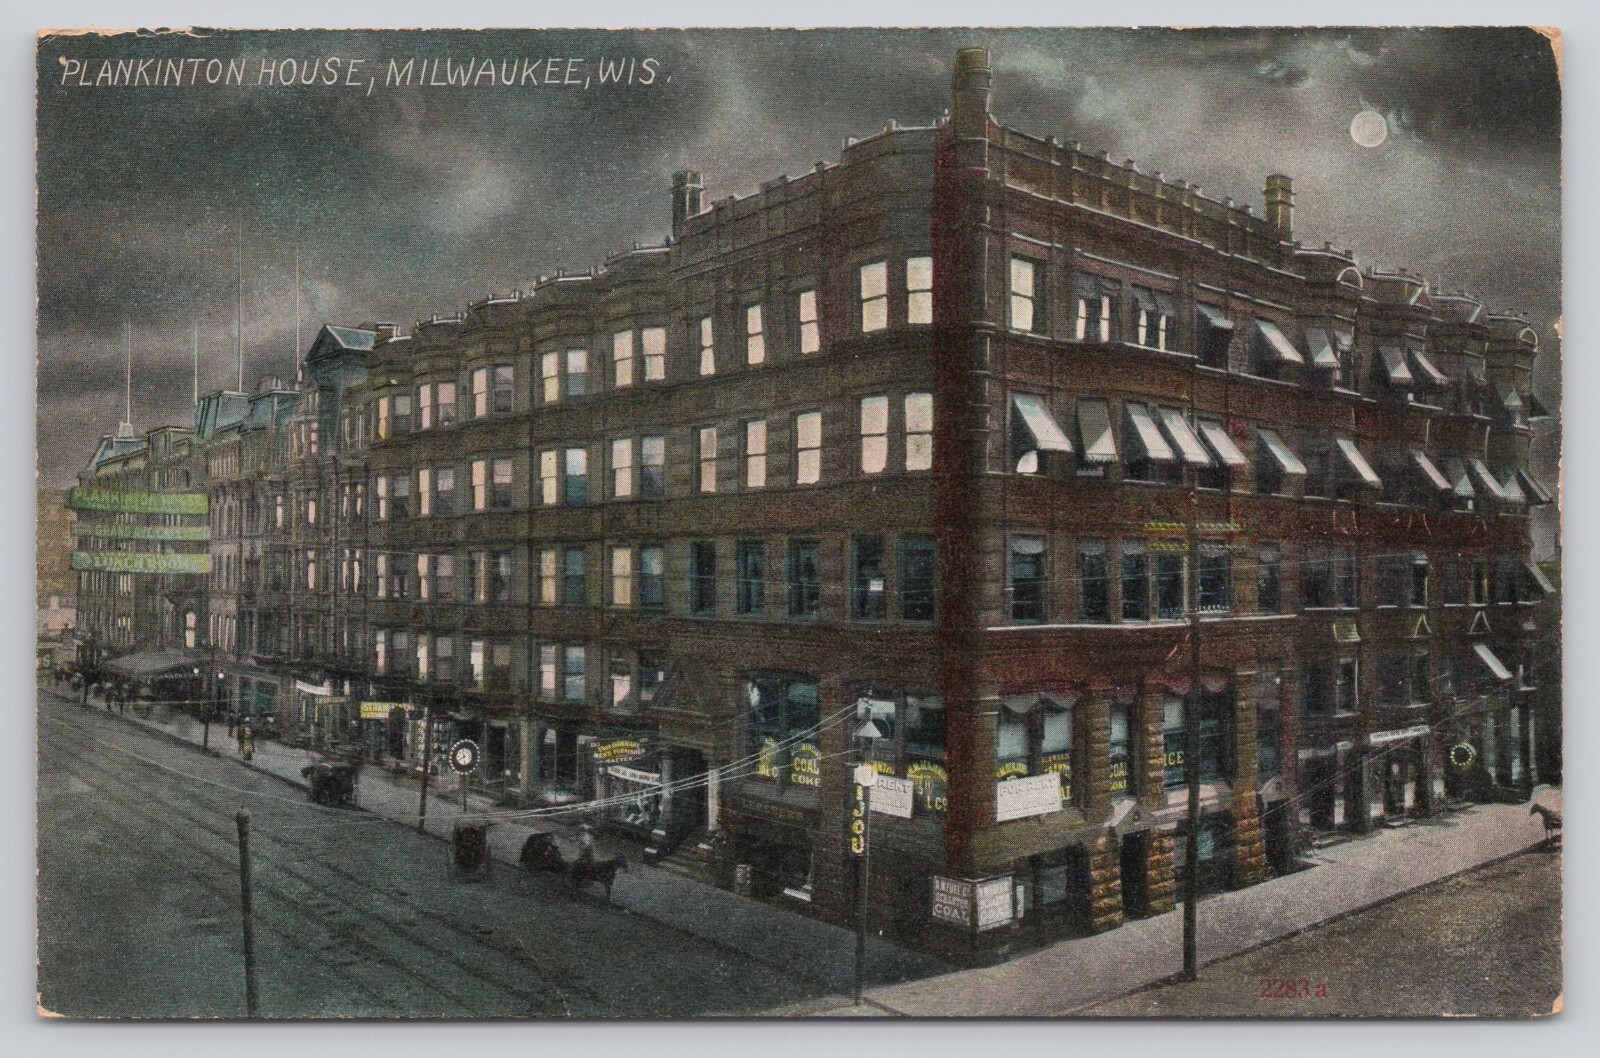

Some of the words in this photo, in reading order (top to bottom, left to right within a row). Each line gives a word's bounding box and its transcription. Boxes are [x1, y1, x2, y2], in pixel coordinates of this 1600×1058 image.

[794, 757, 820, 775] COAL
[791, 774, 822, 788] COKE
[878, 778, 911, 794] RENT
[1000, 783, 1024, 796] FOR
[1026, 778, 1056, 792] RENT
